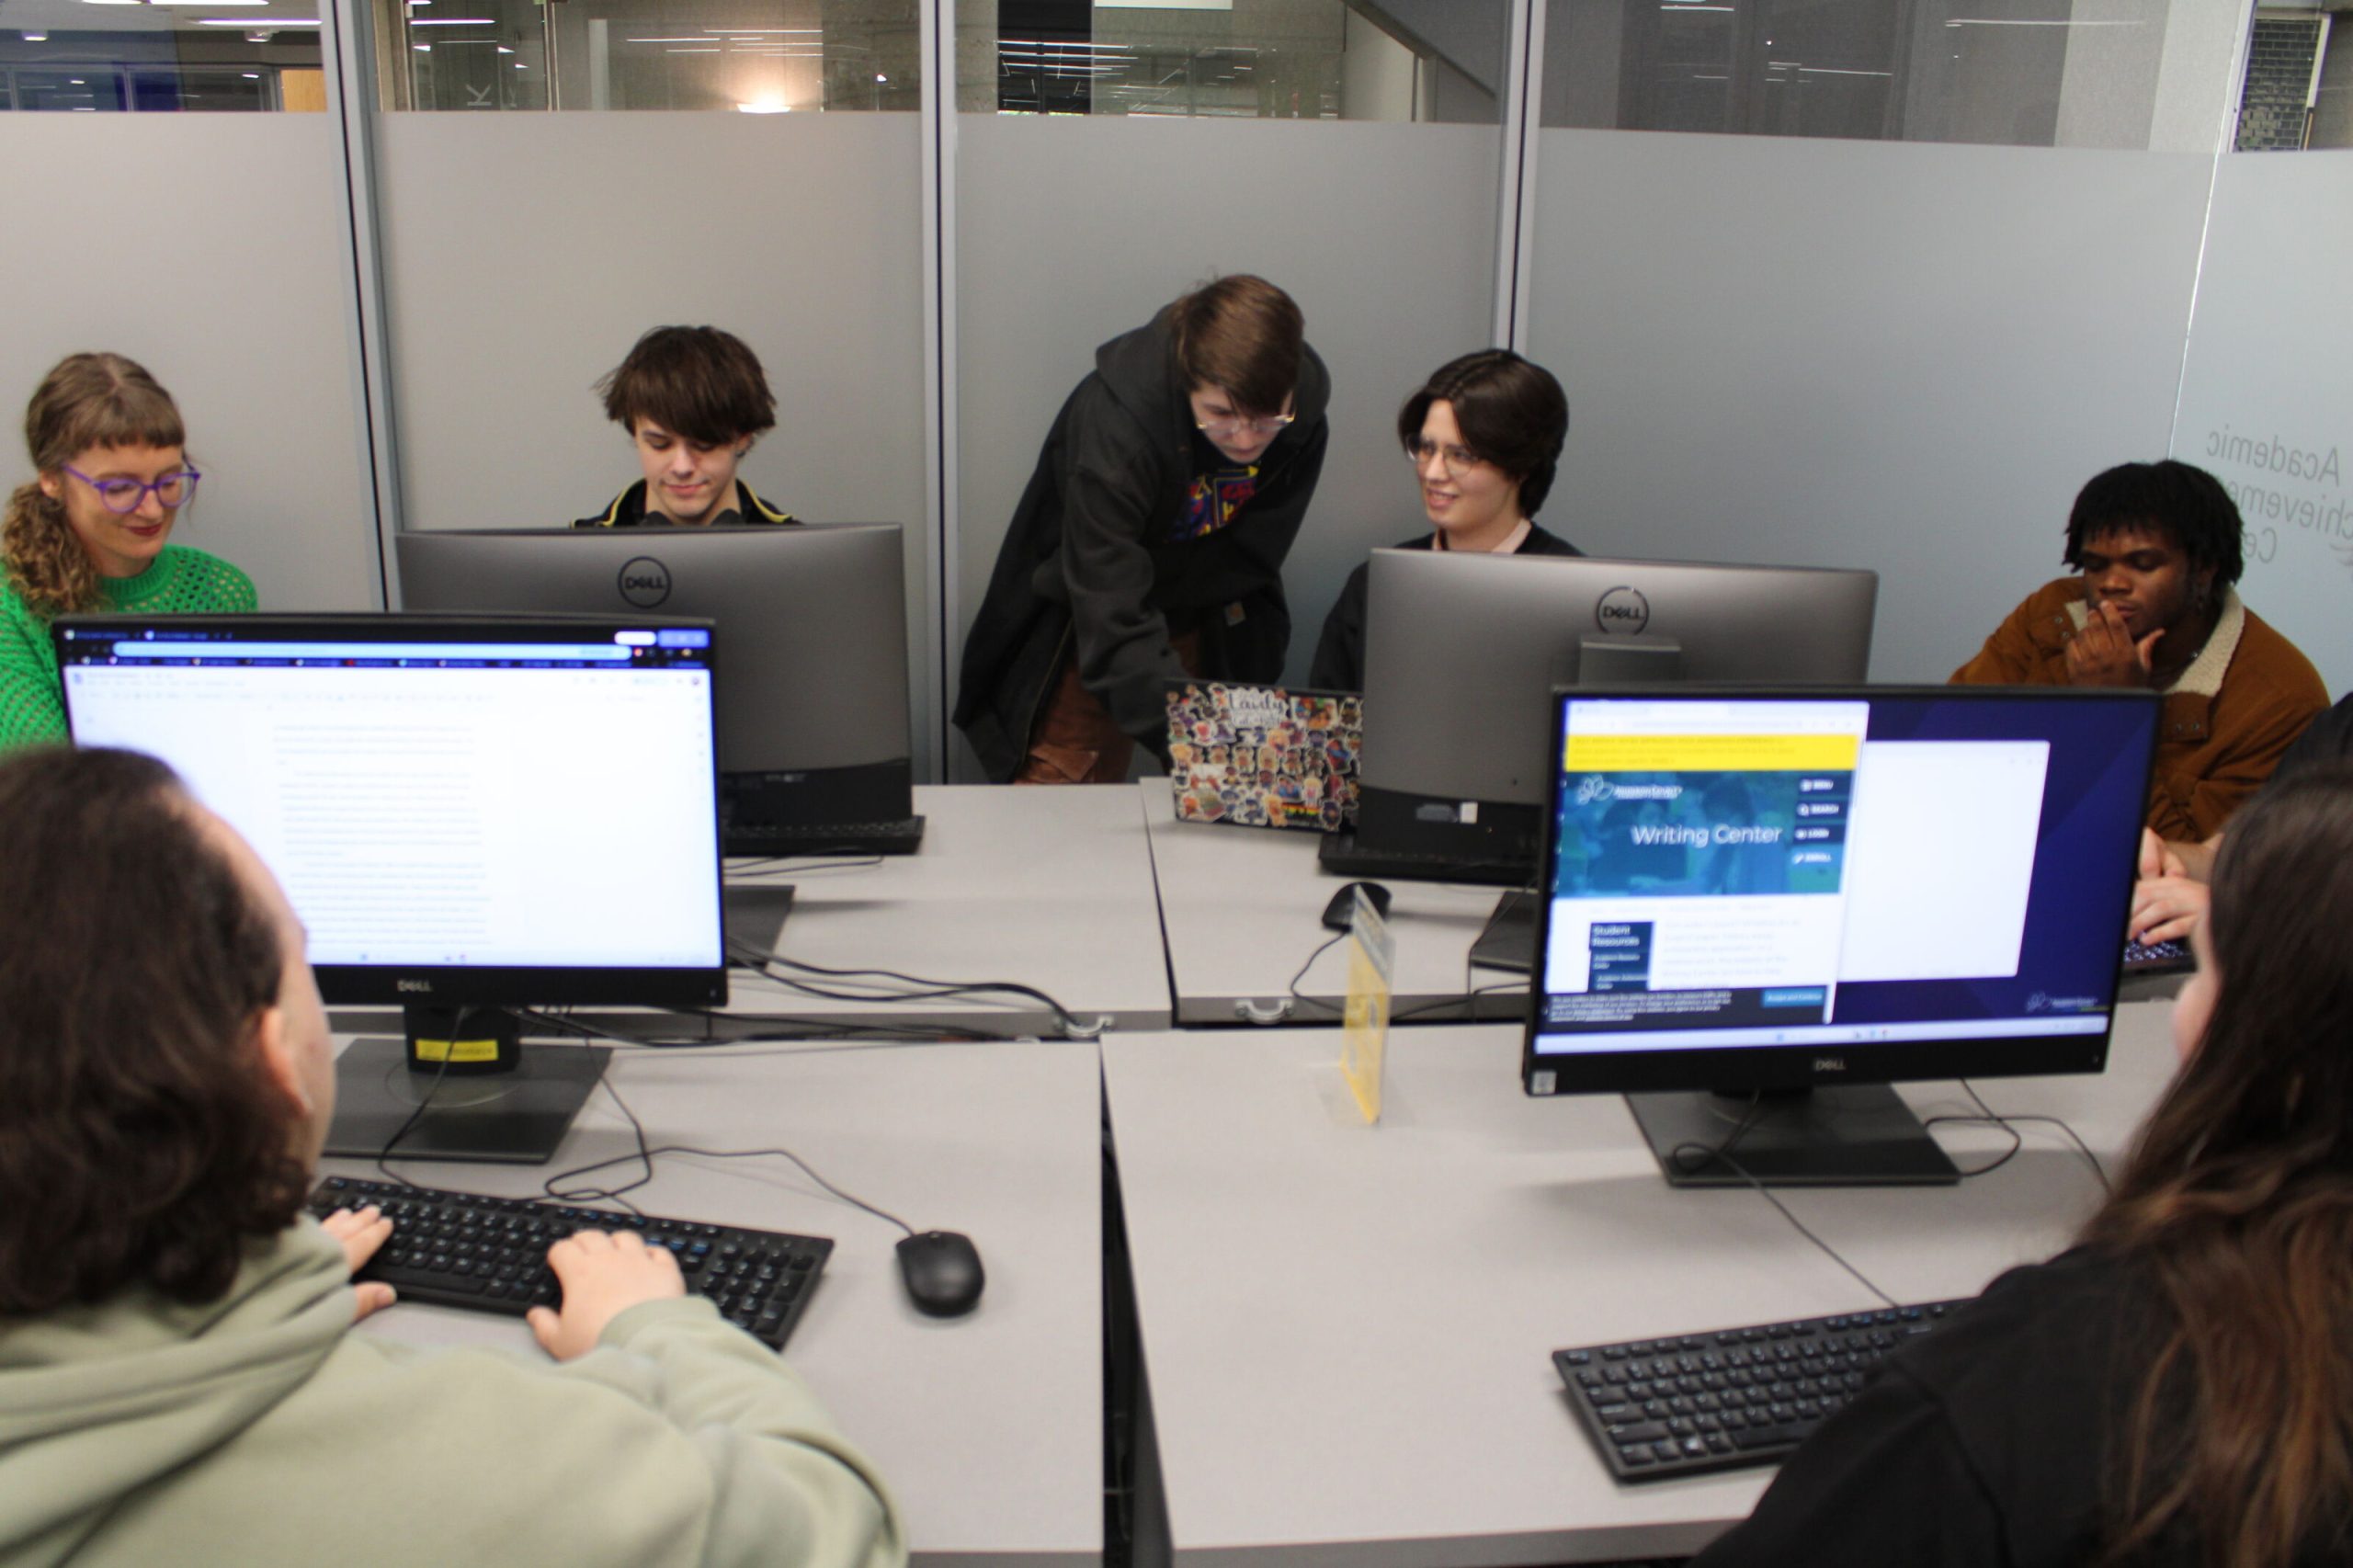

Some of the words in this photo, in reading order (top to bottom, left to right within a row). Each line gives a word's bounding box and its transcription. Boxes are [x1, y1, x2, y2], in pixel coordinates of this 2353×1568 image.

[625, 575, 665, 590] DELL
[1602, 605, 1645, 619] DELL
[1631, 824, 1710, 848] Writing
[1713, 824, 1783, 845] Center
[397, 980, 433, 992] DELL
[1814, 1059, 1846, 1072] DELL
